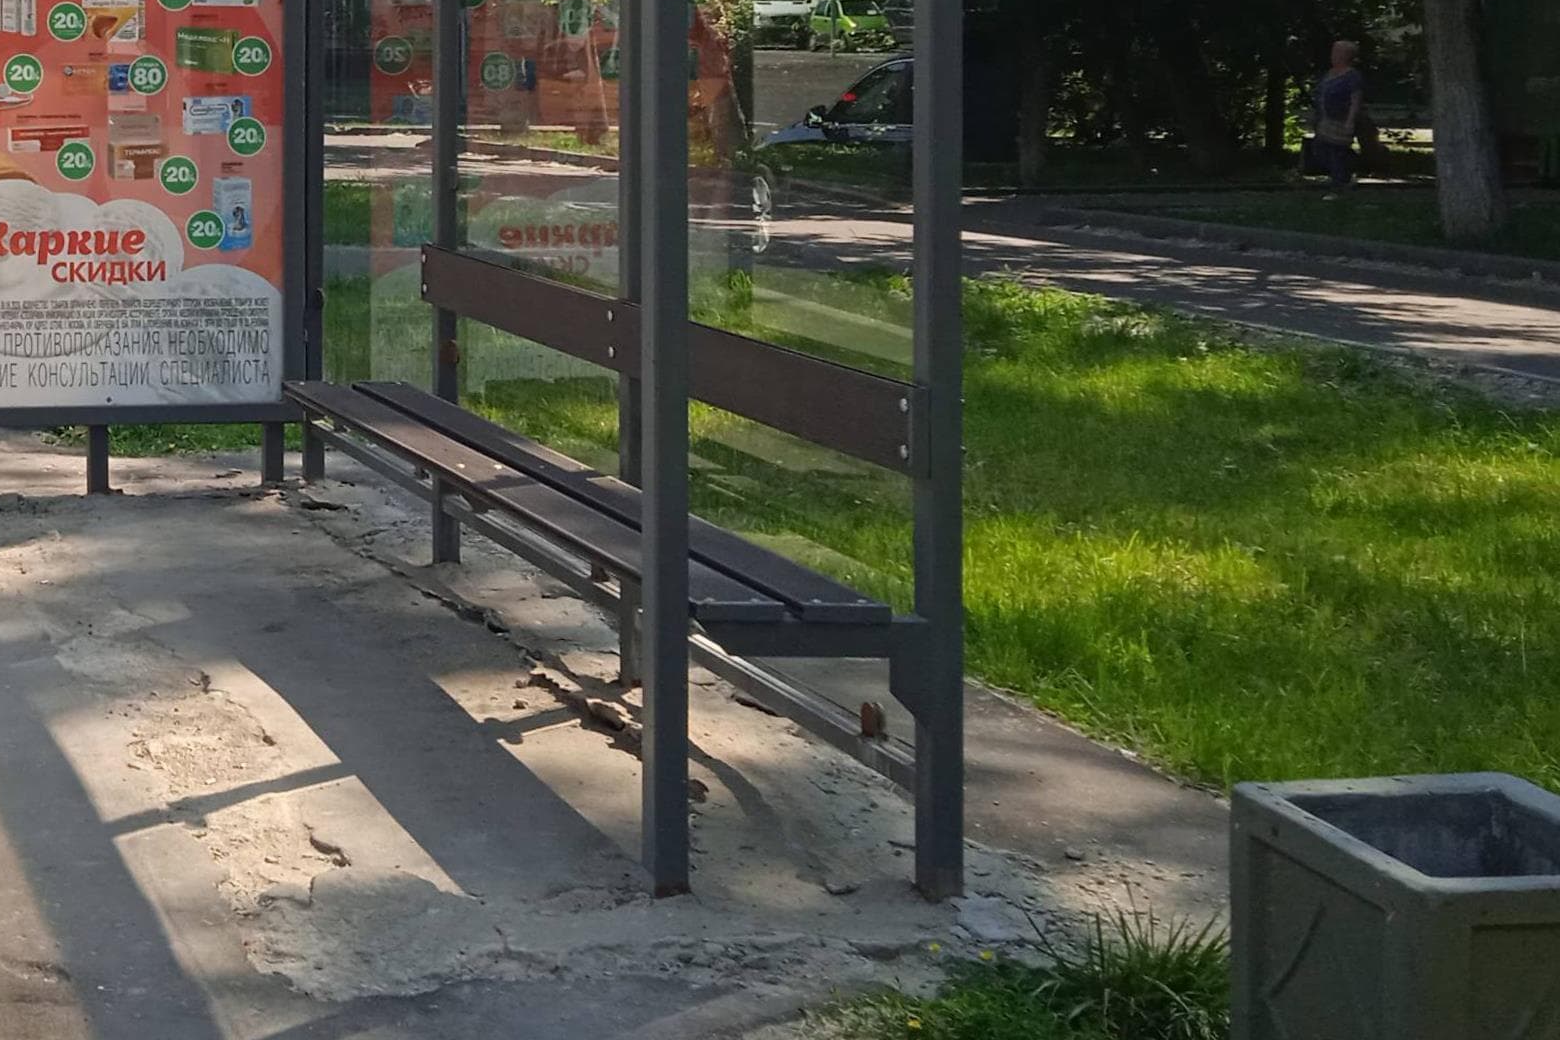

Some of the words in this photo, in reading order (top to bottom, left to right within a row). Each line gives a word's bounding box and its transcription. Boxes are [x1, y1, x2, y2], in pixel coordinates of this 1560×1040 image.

[133, 68, 162, 85] 80
[3, 330, 163, 358] ПРОТИВОПОКАЗАНИЯ.
[168, 329, 270, 356] НЕОБХОДИМО
[28, 361, 150, 388] КОНСУЛЬТАЦИИ
[160, 360, 270, 386] СПЕЦИАЛИСТА
